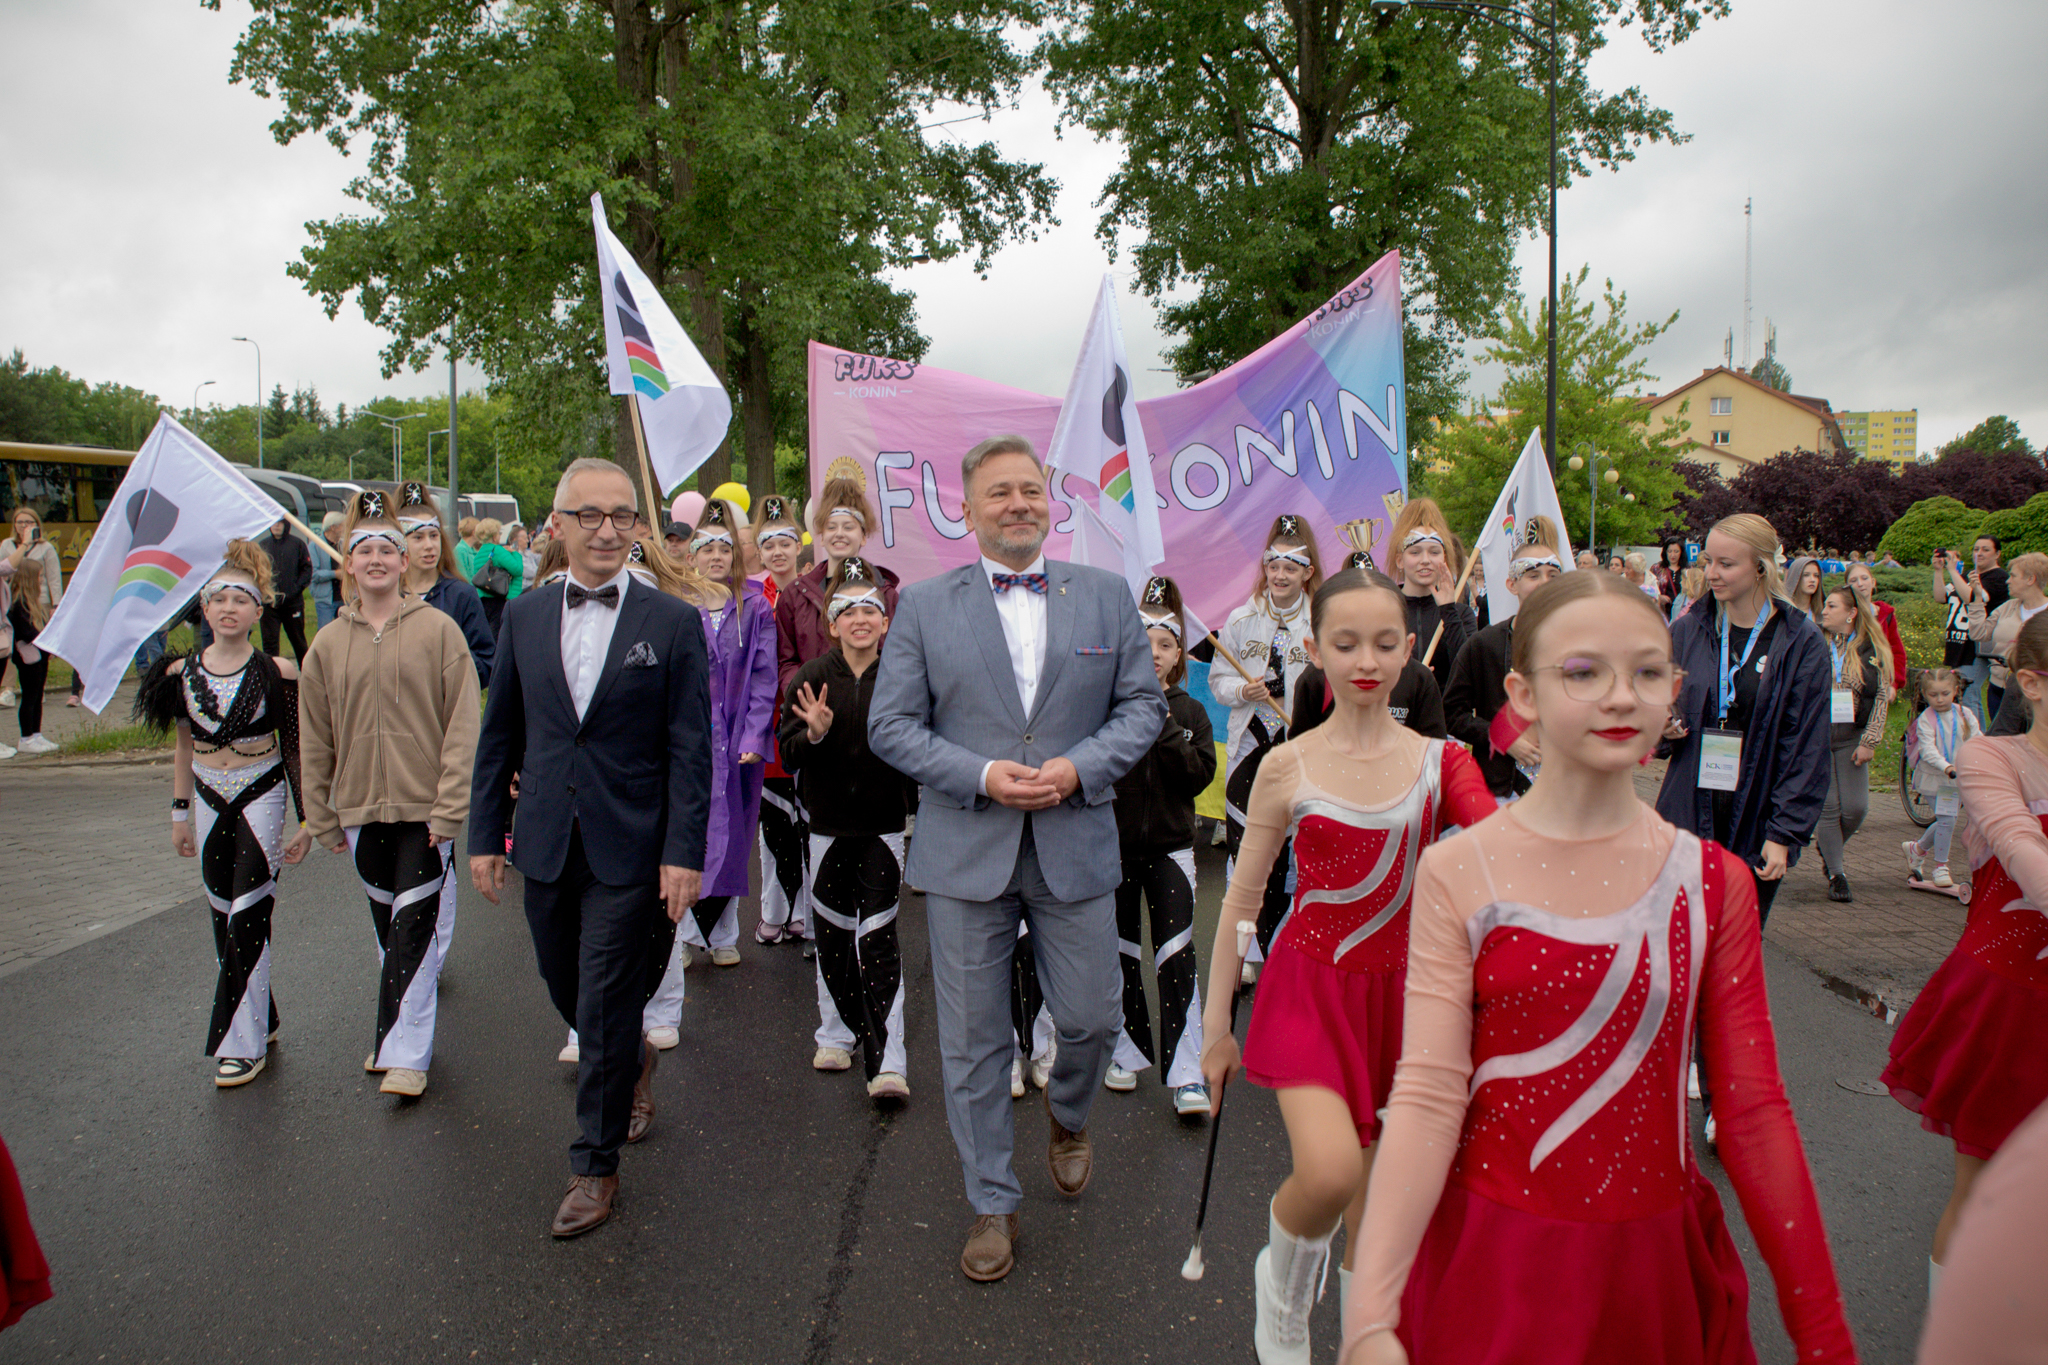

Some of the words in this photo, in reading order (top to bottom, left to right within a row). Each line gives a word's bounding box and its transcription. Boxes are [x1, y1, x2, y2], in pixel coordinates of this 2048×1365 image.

[1311, 308, 1360, 338] KONIN
[834, 354, 918, 381] FUKS
[849, 386, 897, 399] KONIN
[875, 451, 1077, 549] FUS
[1149, 384, 1399, 512] ONIN
[1690, 546, 1699, 560] P
